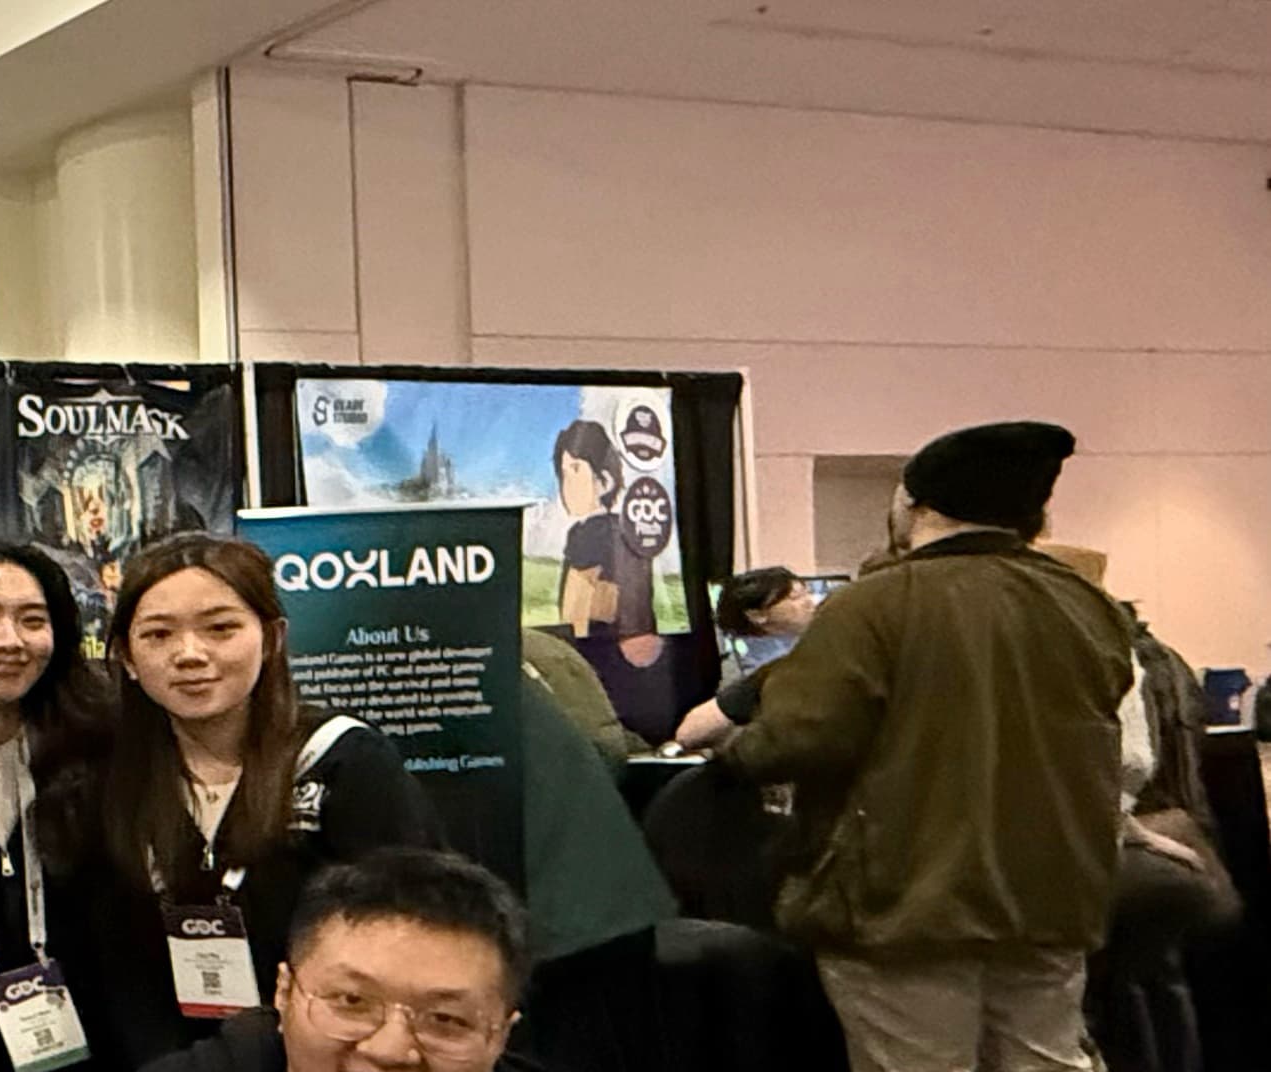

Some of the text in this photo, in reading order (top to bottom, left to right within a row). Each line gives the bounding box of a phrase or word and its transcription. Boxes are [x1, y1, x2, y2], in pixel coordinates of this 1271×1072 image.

[627, 499, 668, 522] GDC
[273, 545, 496, 592] QOXLAND
[345, 624, 431, 646] About Us
[180, 918, 227, 935] GDC
[5, 975, 45, 1000] GDC
